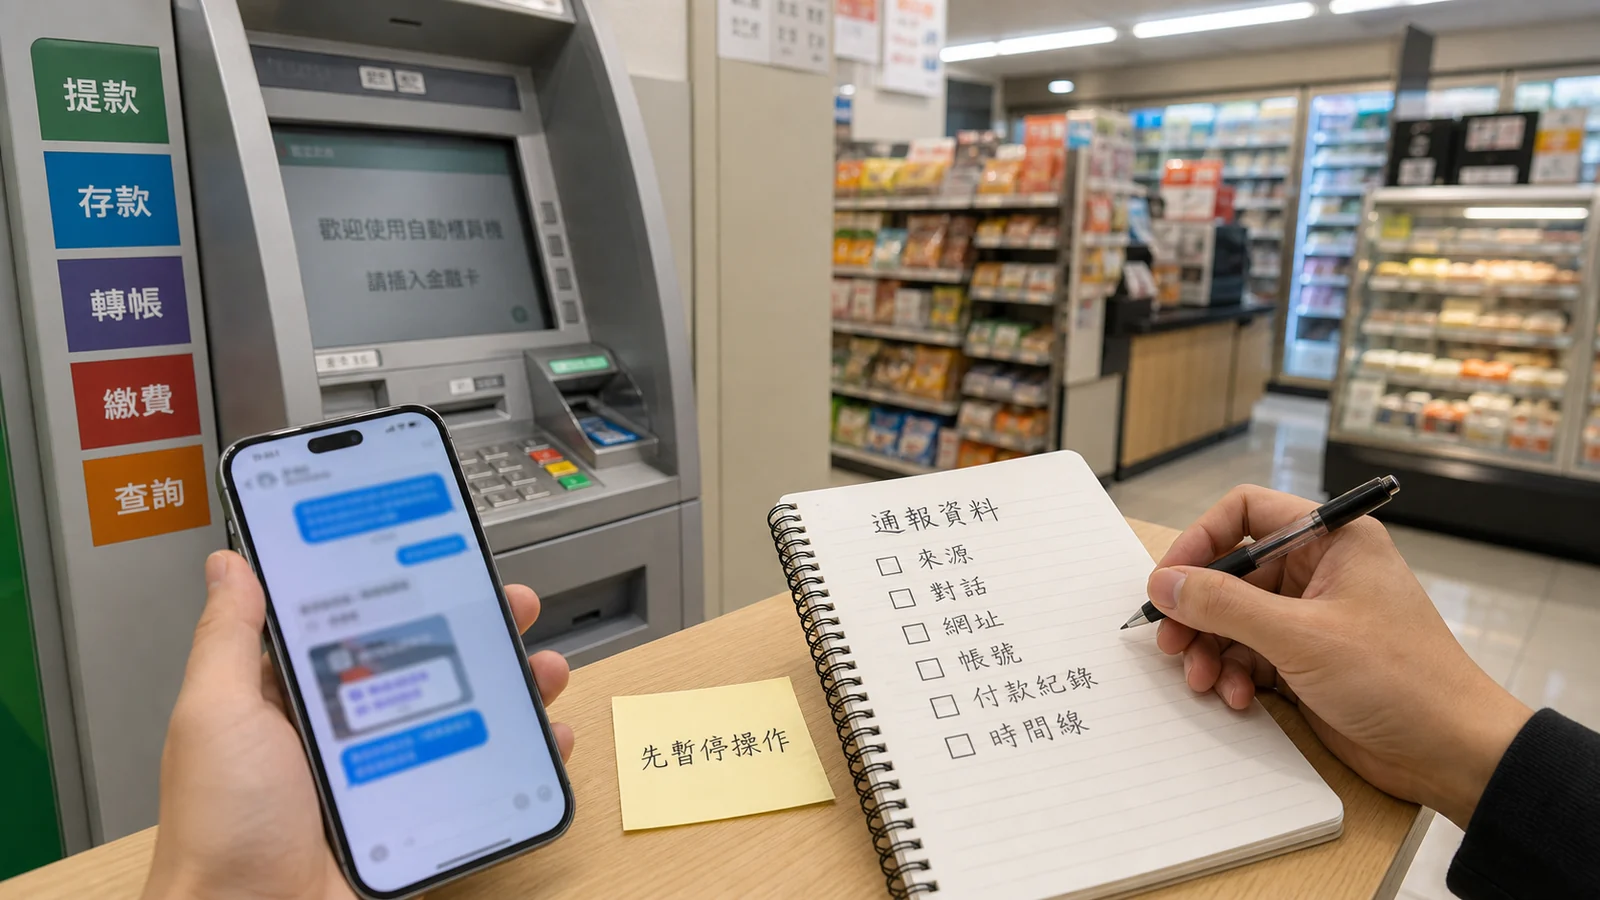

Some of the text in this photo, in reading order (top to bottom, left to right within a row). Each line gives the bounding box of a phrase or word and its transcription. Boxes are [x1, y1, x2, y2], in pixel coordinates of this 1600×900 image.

[63, 77, 140, 115] 提款
[78, 184, 152, 218] 存款
[318, 217, 504, 241] 歡迎使用自動櫃員機
[366, 267, 480, 292] 請插入金融卡
[90, 287, 164, 322] 轉帳
[103, 383, 174, 421] 繳費
[114, 477, 185, 516] 查詢
[871, 498, 999, 535] 通報資料
[918, 544, 974, 570] 來源
[930, 576, 987, 602] 對話
[942, 610, 1004, 637] 網址
[957, 642, 1022, 673] 帳號
[973, 667, 1099, 709] 付款紀錄
[989, 710, 1090, 749] 時間線
[641, 727, 790, 770] 先暫停操作
